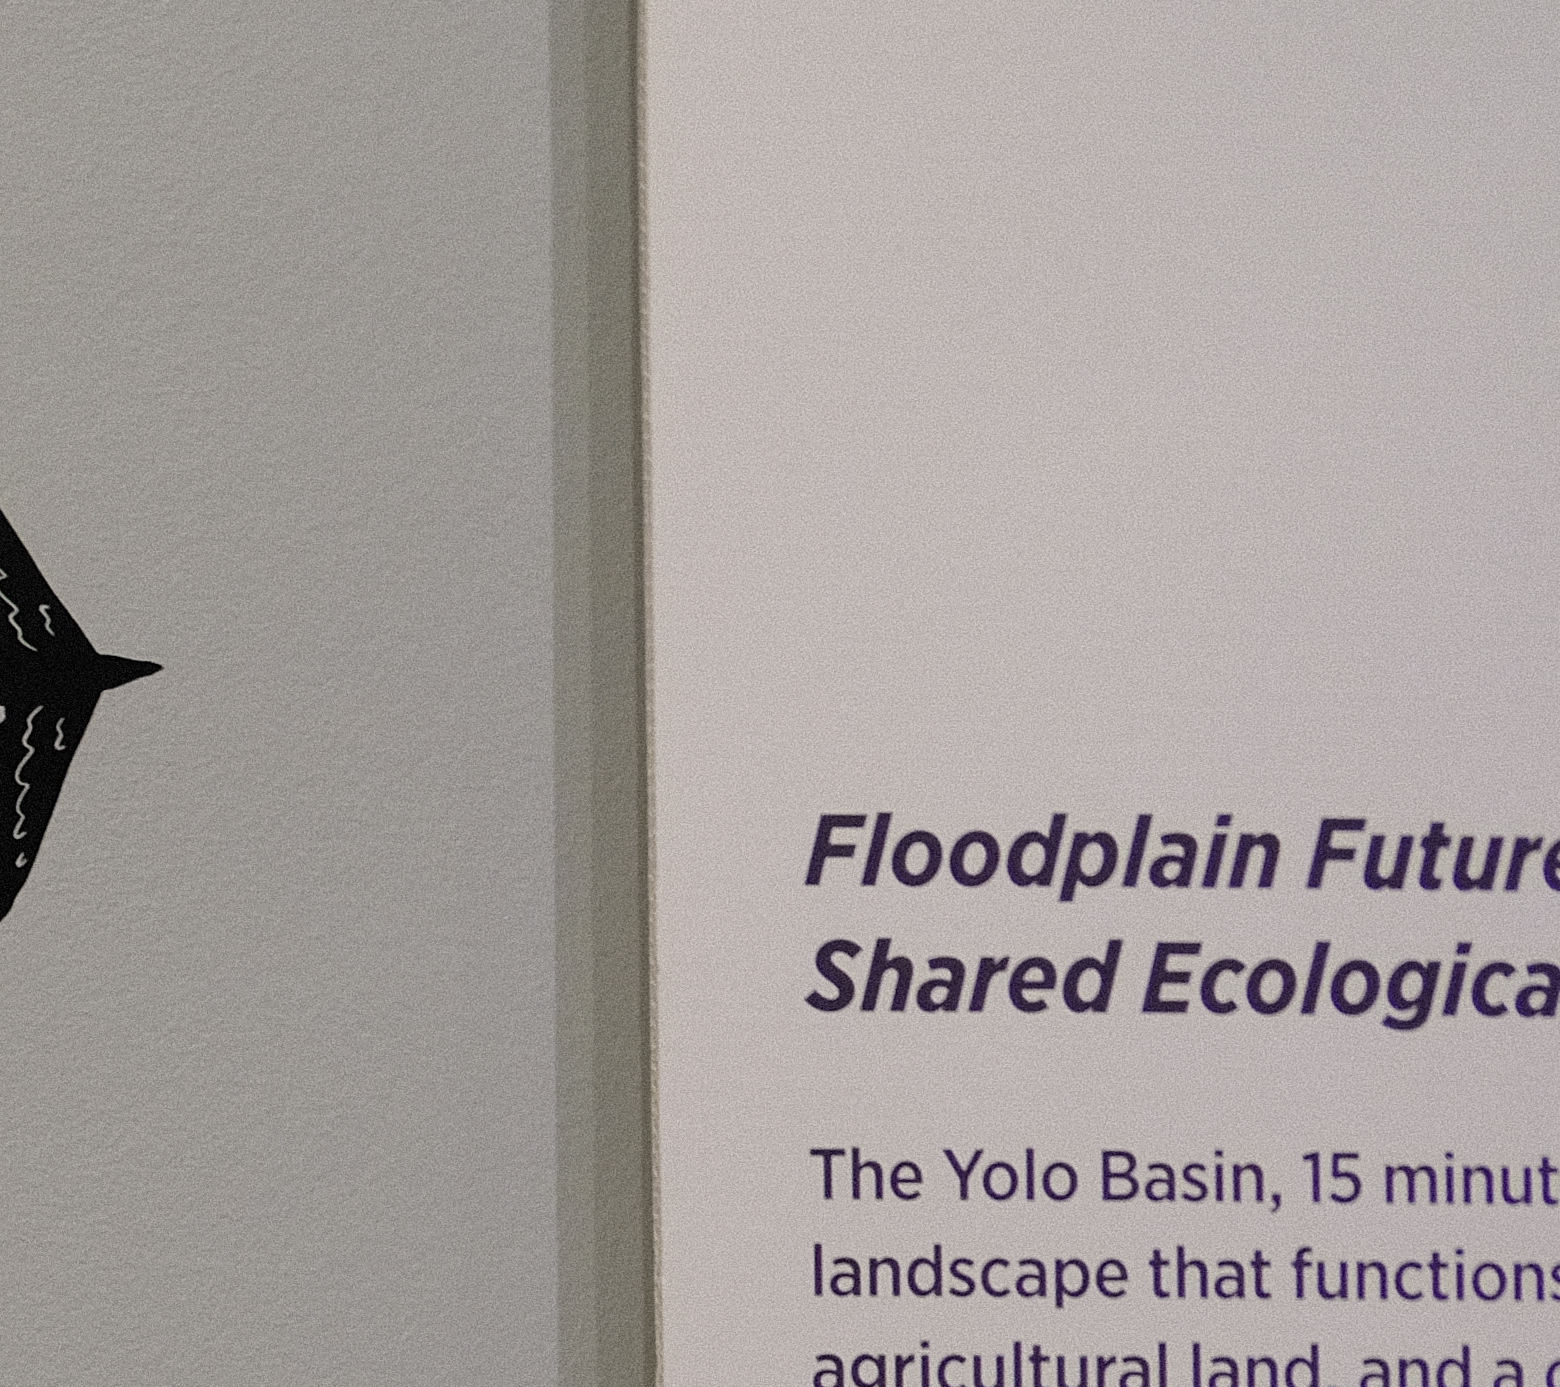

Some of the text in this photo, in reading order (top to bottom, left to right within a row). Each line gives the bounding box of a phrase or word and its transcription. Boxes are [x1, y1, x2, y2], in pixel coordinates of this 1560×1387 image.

[805, 812, 1280, 902] Floodplain
[806, 938, 1560, 1031] Shared Ecologica
[810, 1147, 1558, 1212] The Yolo Basin, 15 minut
[814, 1243, 1128, 1308] landscape
[1149, 1245, 1271, 1299] that
